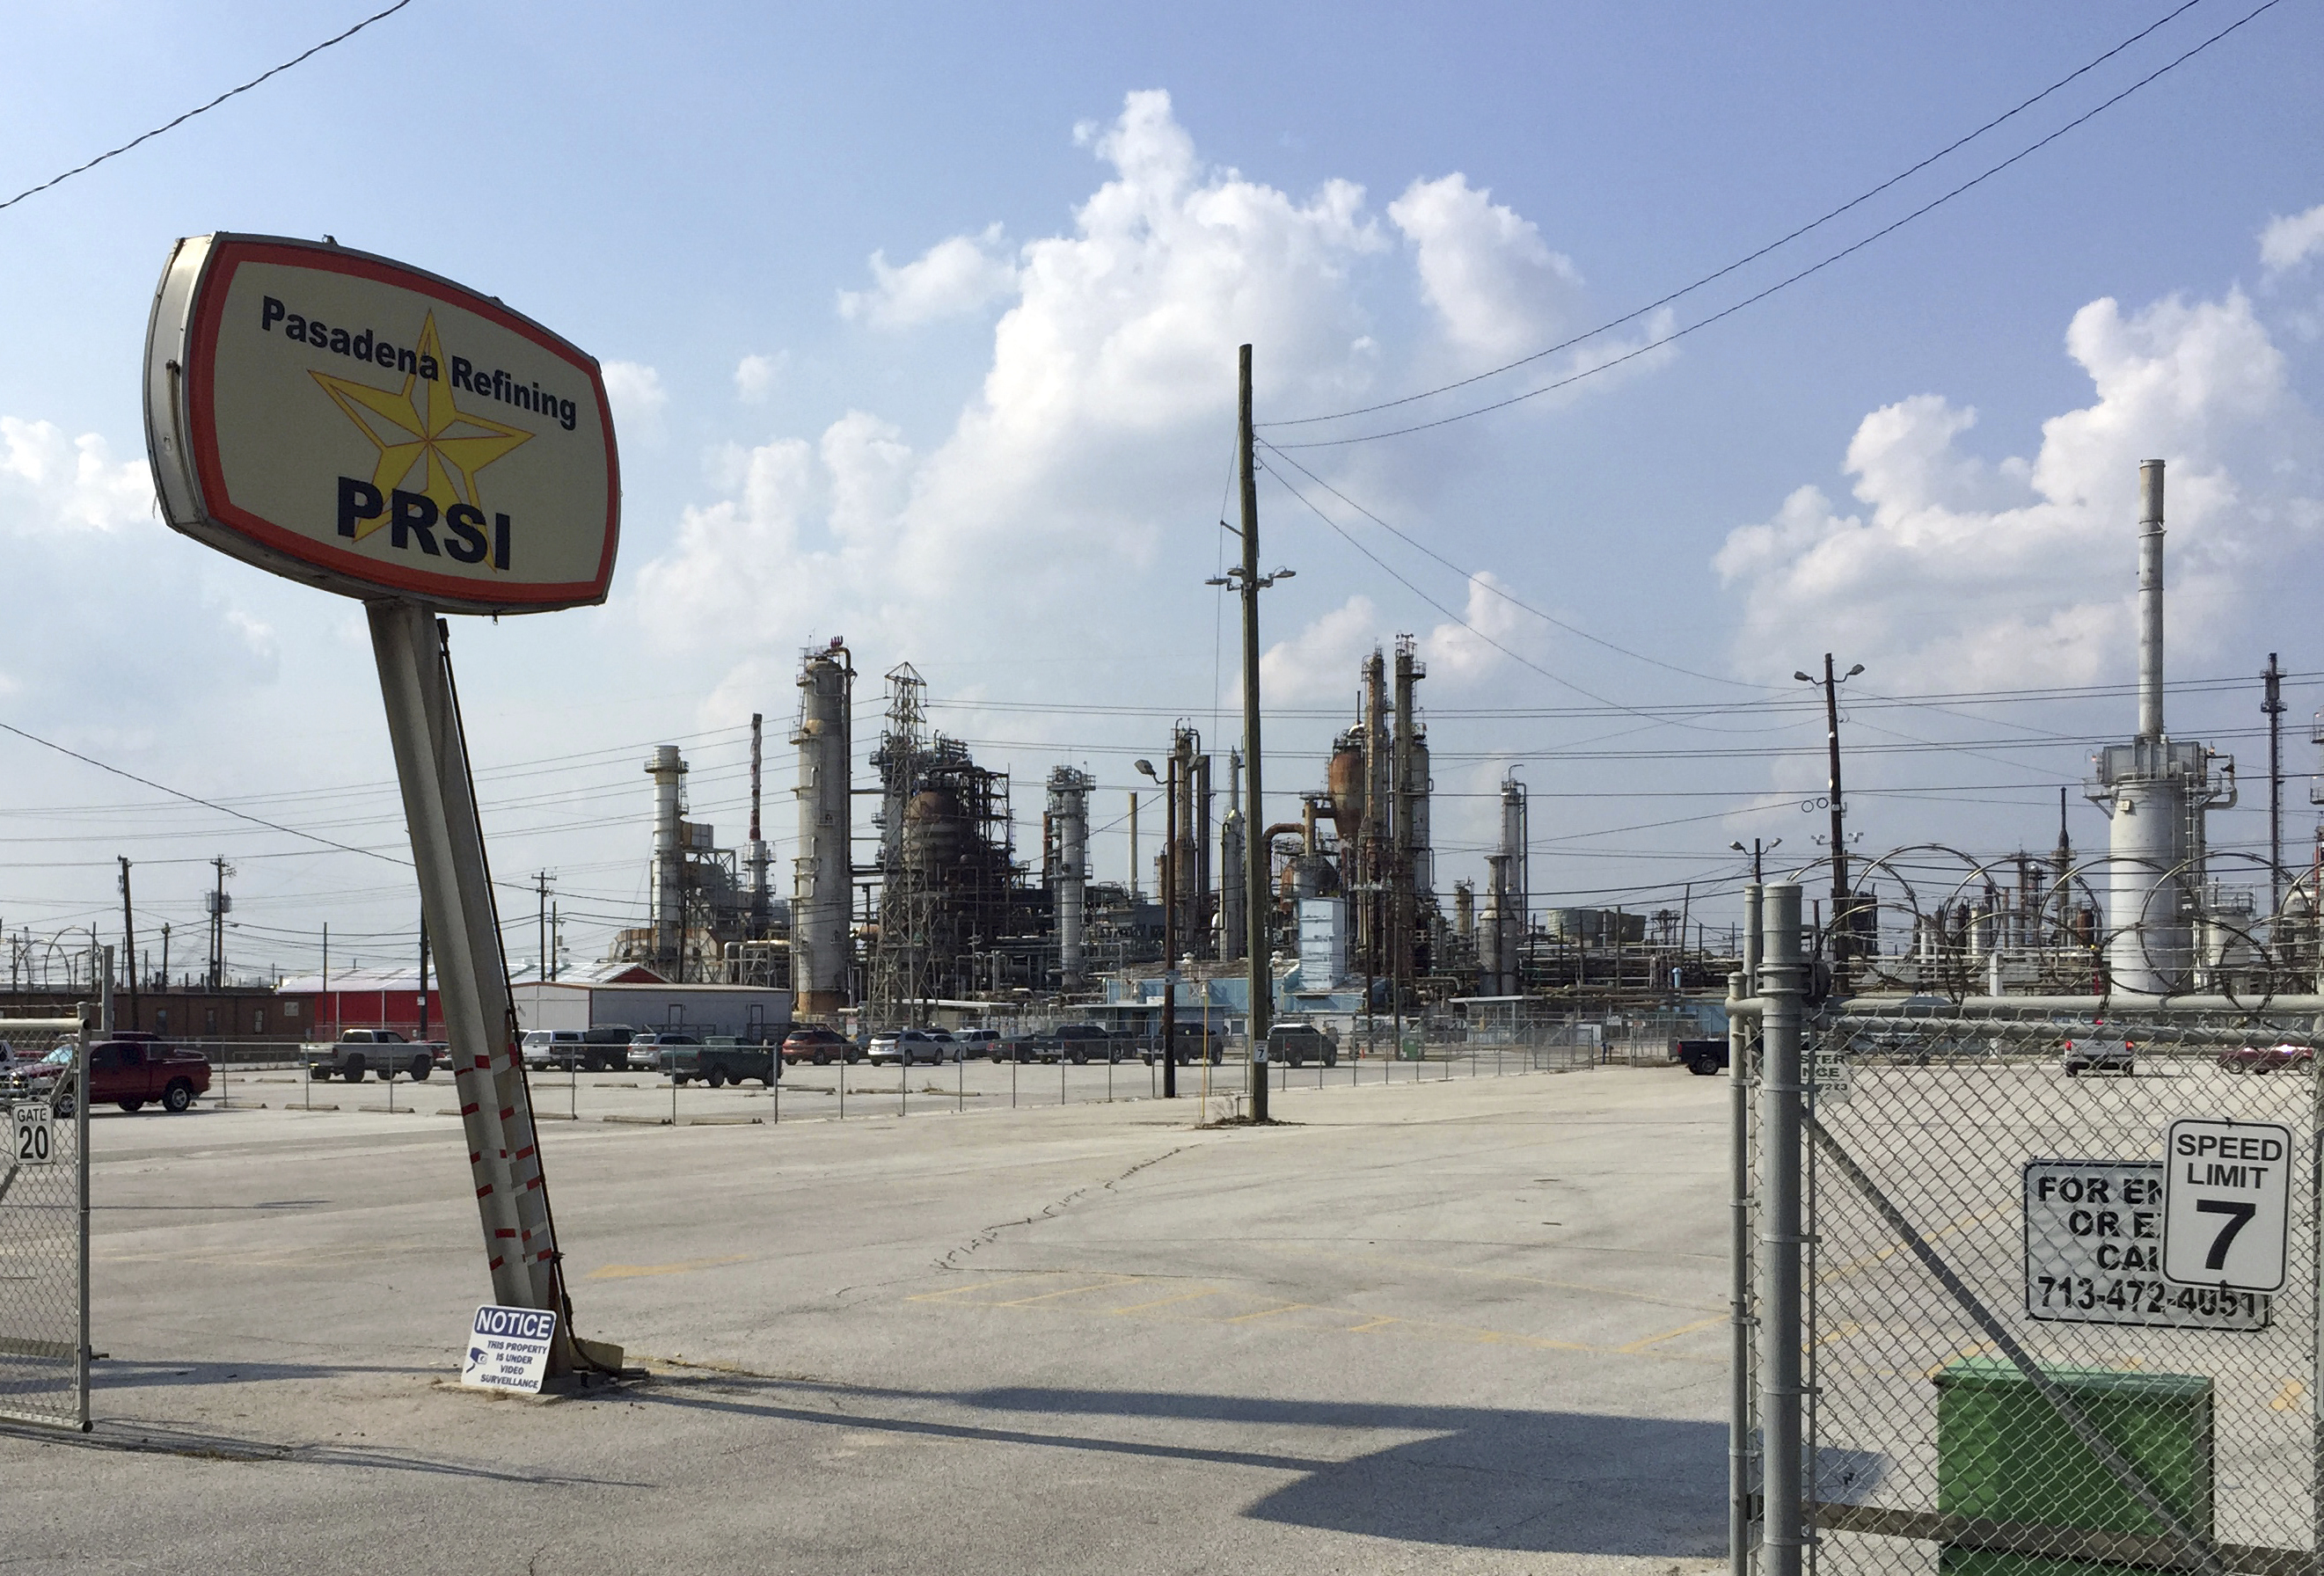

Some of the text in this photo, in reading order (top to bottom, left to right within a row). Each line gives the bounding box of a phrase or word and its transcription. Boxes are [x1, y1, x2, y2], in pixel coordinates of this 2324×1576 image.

[261, 296, 576, 430] Pasadena Refining
[338, 476, 510, 570] PRSI
[18, 1108, 47, 1122] GATE
[19, 1126, 48, 1159] 20
[2176, 1134, 2283, 1162] SPEED
[2187, 1163, 2269, 1189] LIMIT
[2038, 1177, 2110, 1204] FOR
[2069, 1210, 2121, 1237] OR
[2196, 1199, 2256, 1270] 7
[2097, 1244, 2160, 1272] CAL
[2038, 1275, 2255, 1318] 713-472-4051
[476, 1310, 552, 1338] NOTICE
[487, 1340, 548, 1354] THIS PROPERTY
[506, 1353, 533, 1364] UNDER
[480, 1374, 539, 1389] SURVEILLANCE
[501, 1365, 524, 1375] VIDEO
